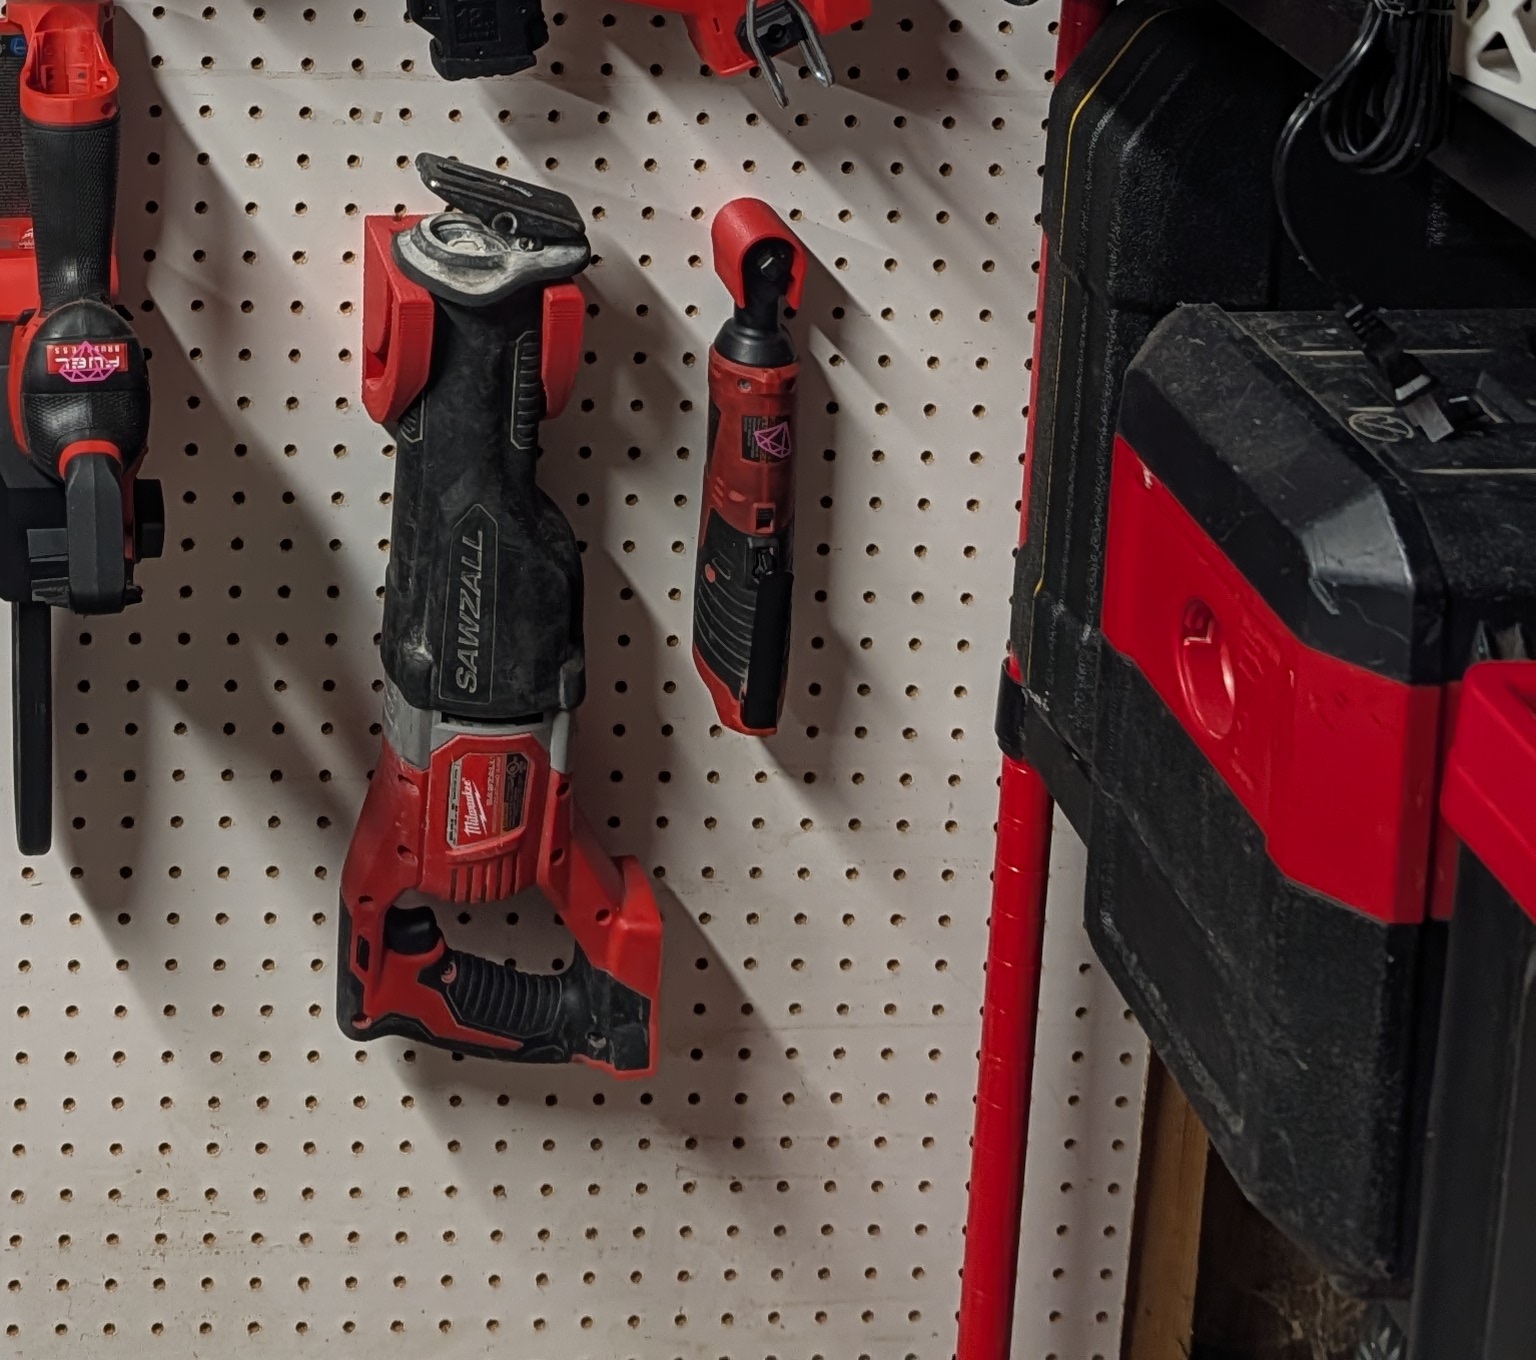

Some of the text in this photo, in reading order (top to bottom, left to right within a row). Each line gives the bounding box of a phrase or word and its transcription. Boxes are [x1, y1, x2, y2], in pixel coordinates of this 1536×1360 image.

[56, 356, 119, 370] FUEL
[455, 530, 484, 694] SAWZALL
[462, 780, 481, 837] Milwaukee
